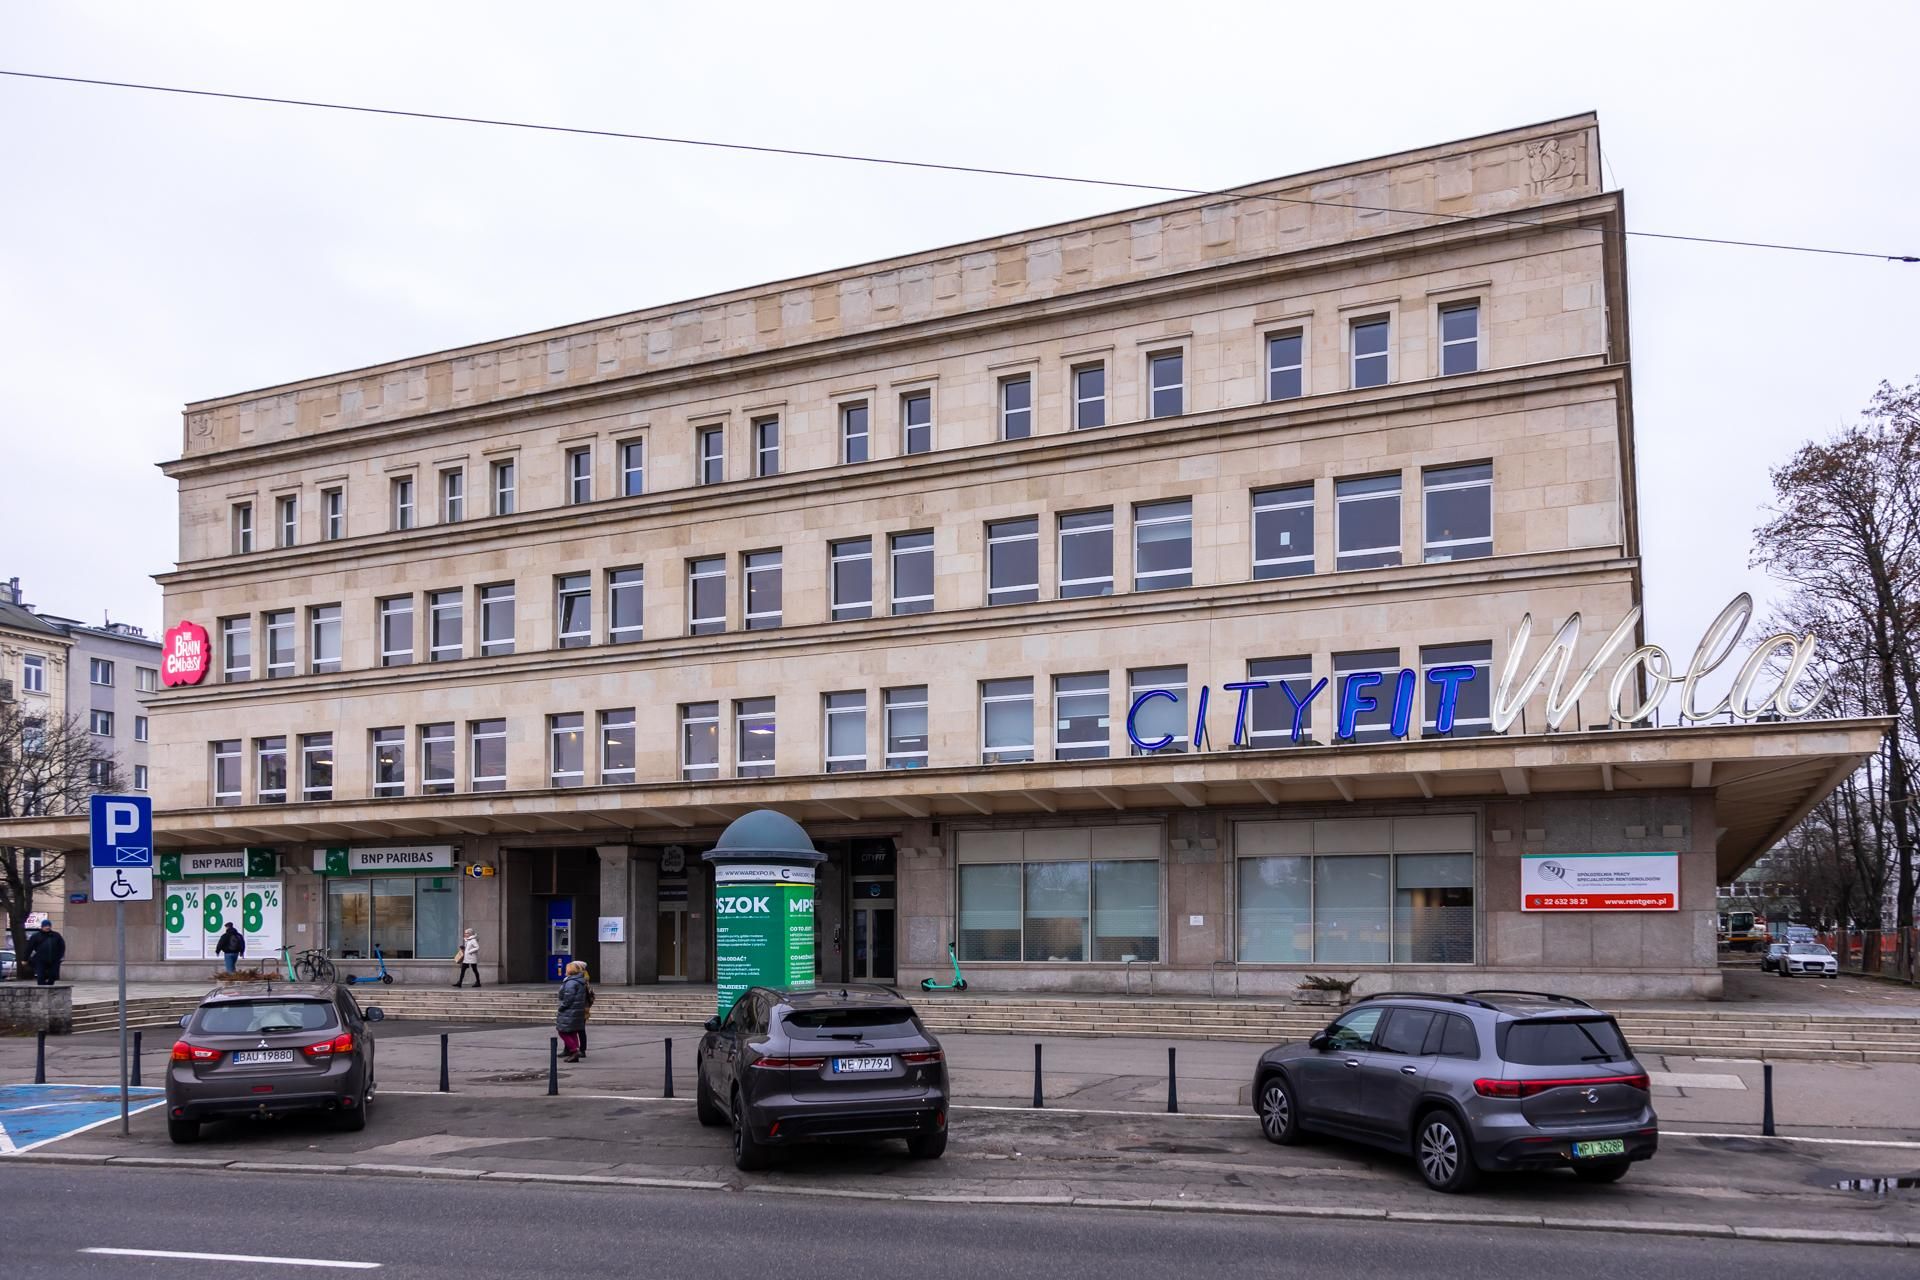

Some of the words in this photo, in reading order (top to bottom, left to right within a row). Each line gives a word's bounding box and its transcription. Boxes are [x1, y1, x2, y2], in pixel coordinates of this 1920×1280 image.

[1127, 665, 1477, 750] CITYFIT
[1491, 591, 1829, 734] Wola
[106, 802, 140, 845] P
[192, 859, 212, 869] BNP
[214, 858, 244, 868] PARIB
[361, 853, 383, 864] BNP
[386, 852, 433, 863] PARIBAS
[1604, 897, 1667, 906] www.rentgen.pl
[240, 1052, 259, 1062] BAU
[262, 1050, 292, 1060] 19880
[840, 1059, 854, 1069] WE
[857, 1058, 890, 1069] 7P794
